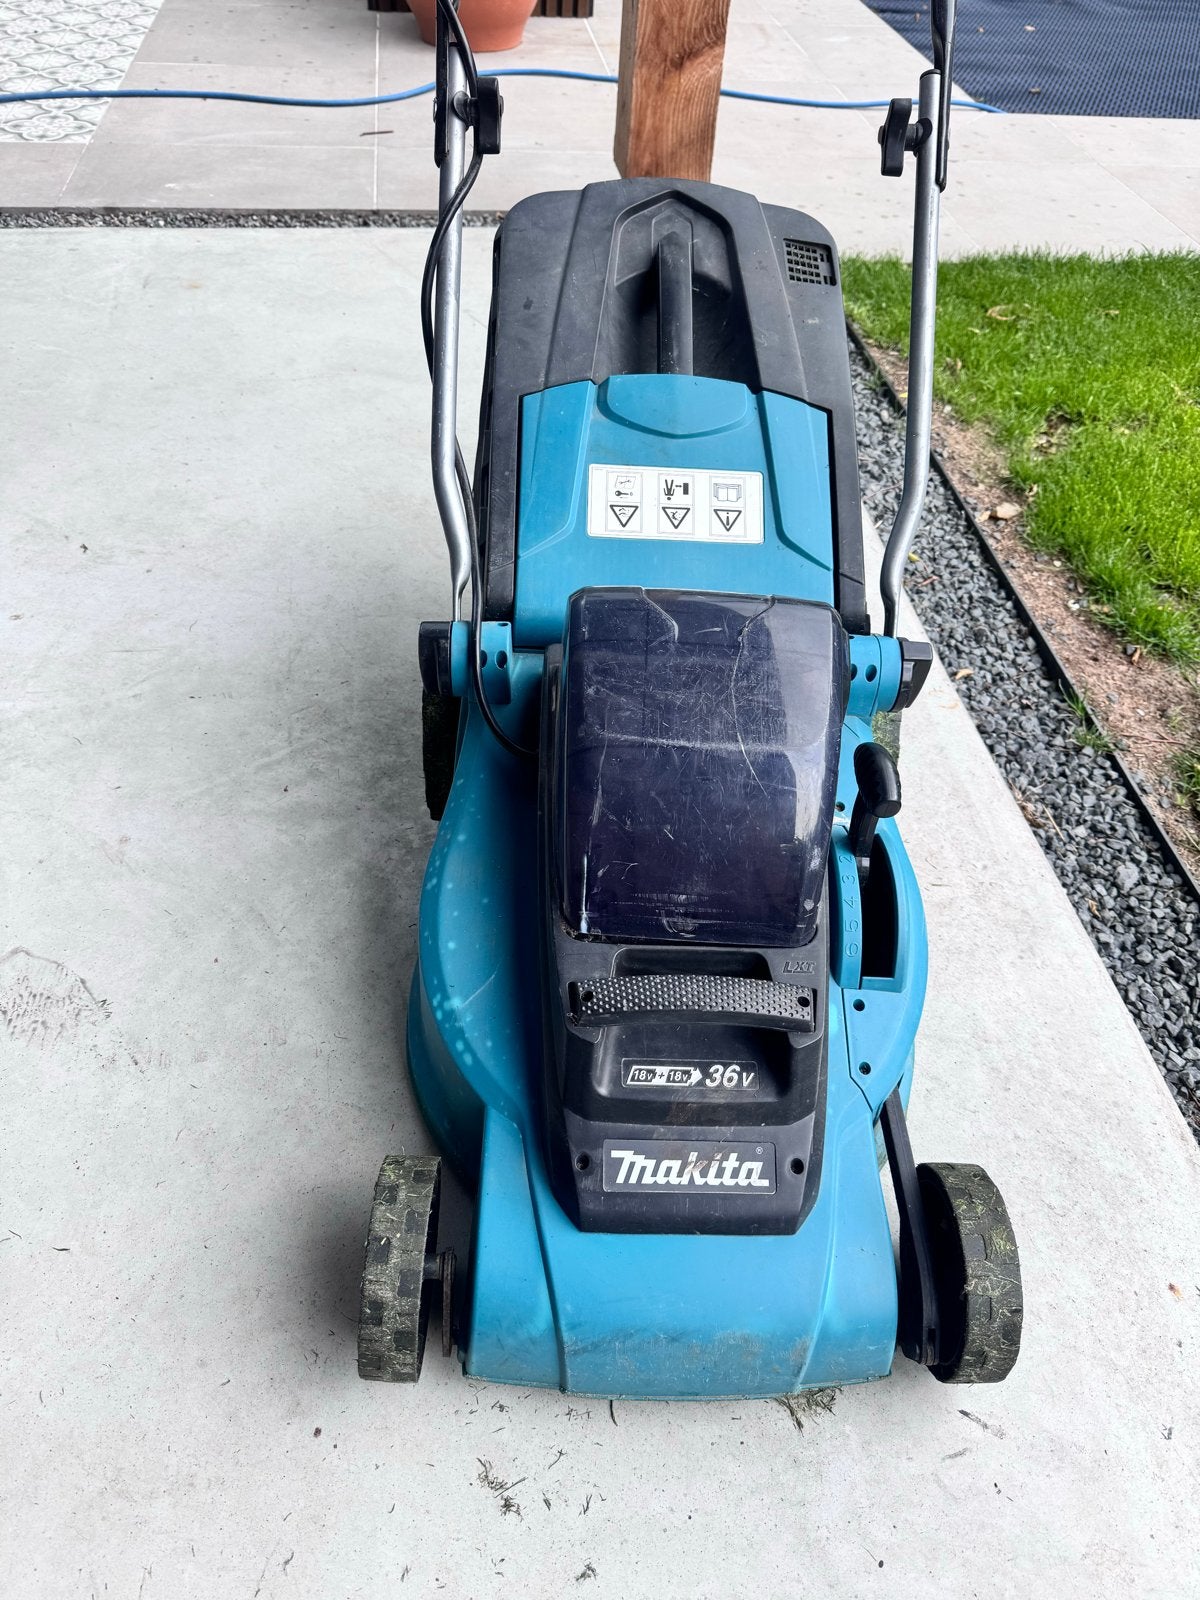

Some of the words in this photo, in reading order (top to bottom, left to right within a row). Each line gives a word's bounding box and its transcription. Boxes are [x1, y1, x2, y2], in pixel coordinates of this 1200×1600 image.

[842, 875, 856, 885] 3
[843, 896, 855, 909] 4
[845, 919, 859, 932] 5
[845, 943, 859, 958] 6
[783, 960, 816, 975] LXT
